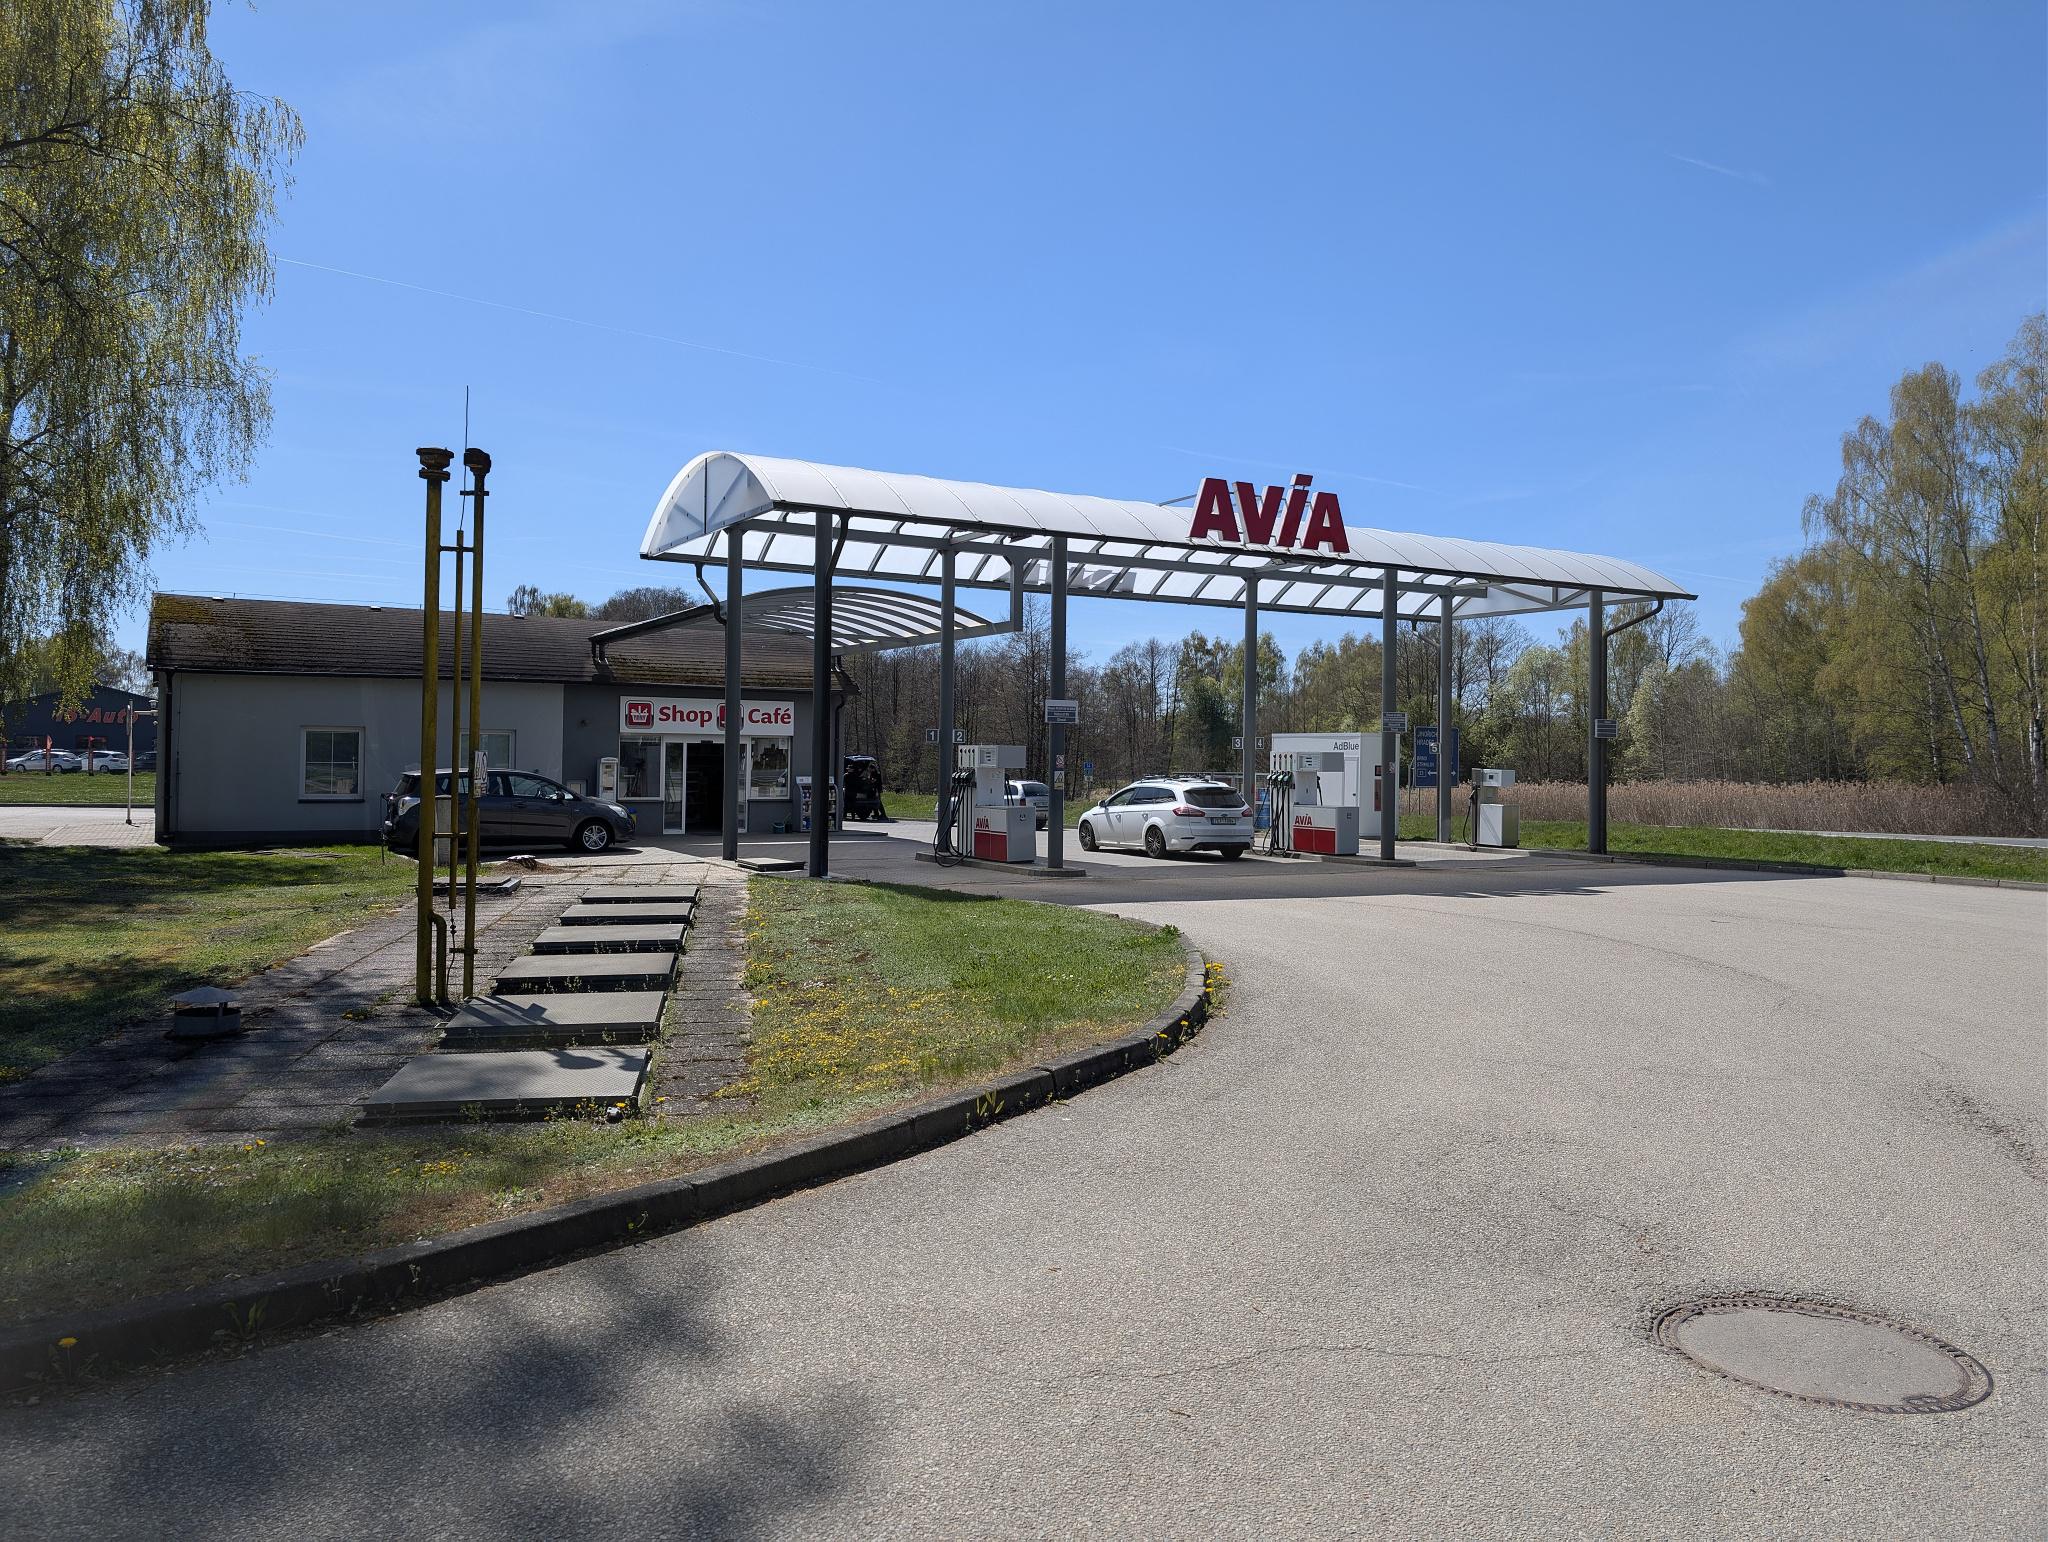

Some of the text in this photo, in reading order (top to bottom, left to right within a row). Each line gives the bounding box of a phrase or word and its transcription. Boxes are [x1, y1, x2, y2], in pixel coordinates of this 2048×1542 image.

[658, 704, 792, 728] Shop Café
[930, 731, 935, 741] 1
[956, 731, 963, 741] 2
[1234, 738, 1241, 748] 3
[1257, 738, 1263, 748] 4
[1333, 741, 1360, 751] AdBlue
[1431, 743, 1438, 753] 5
